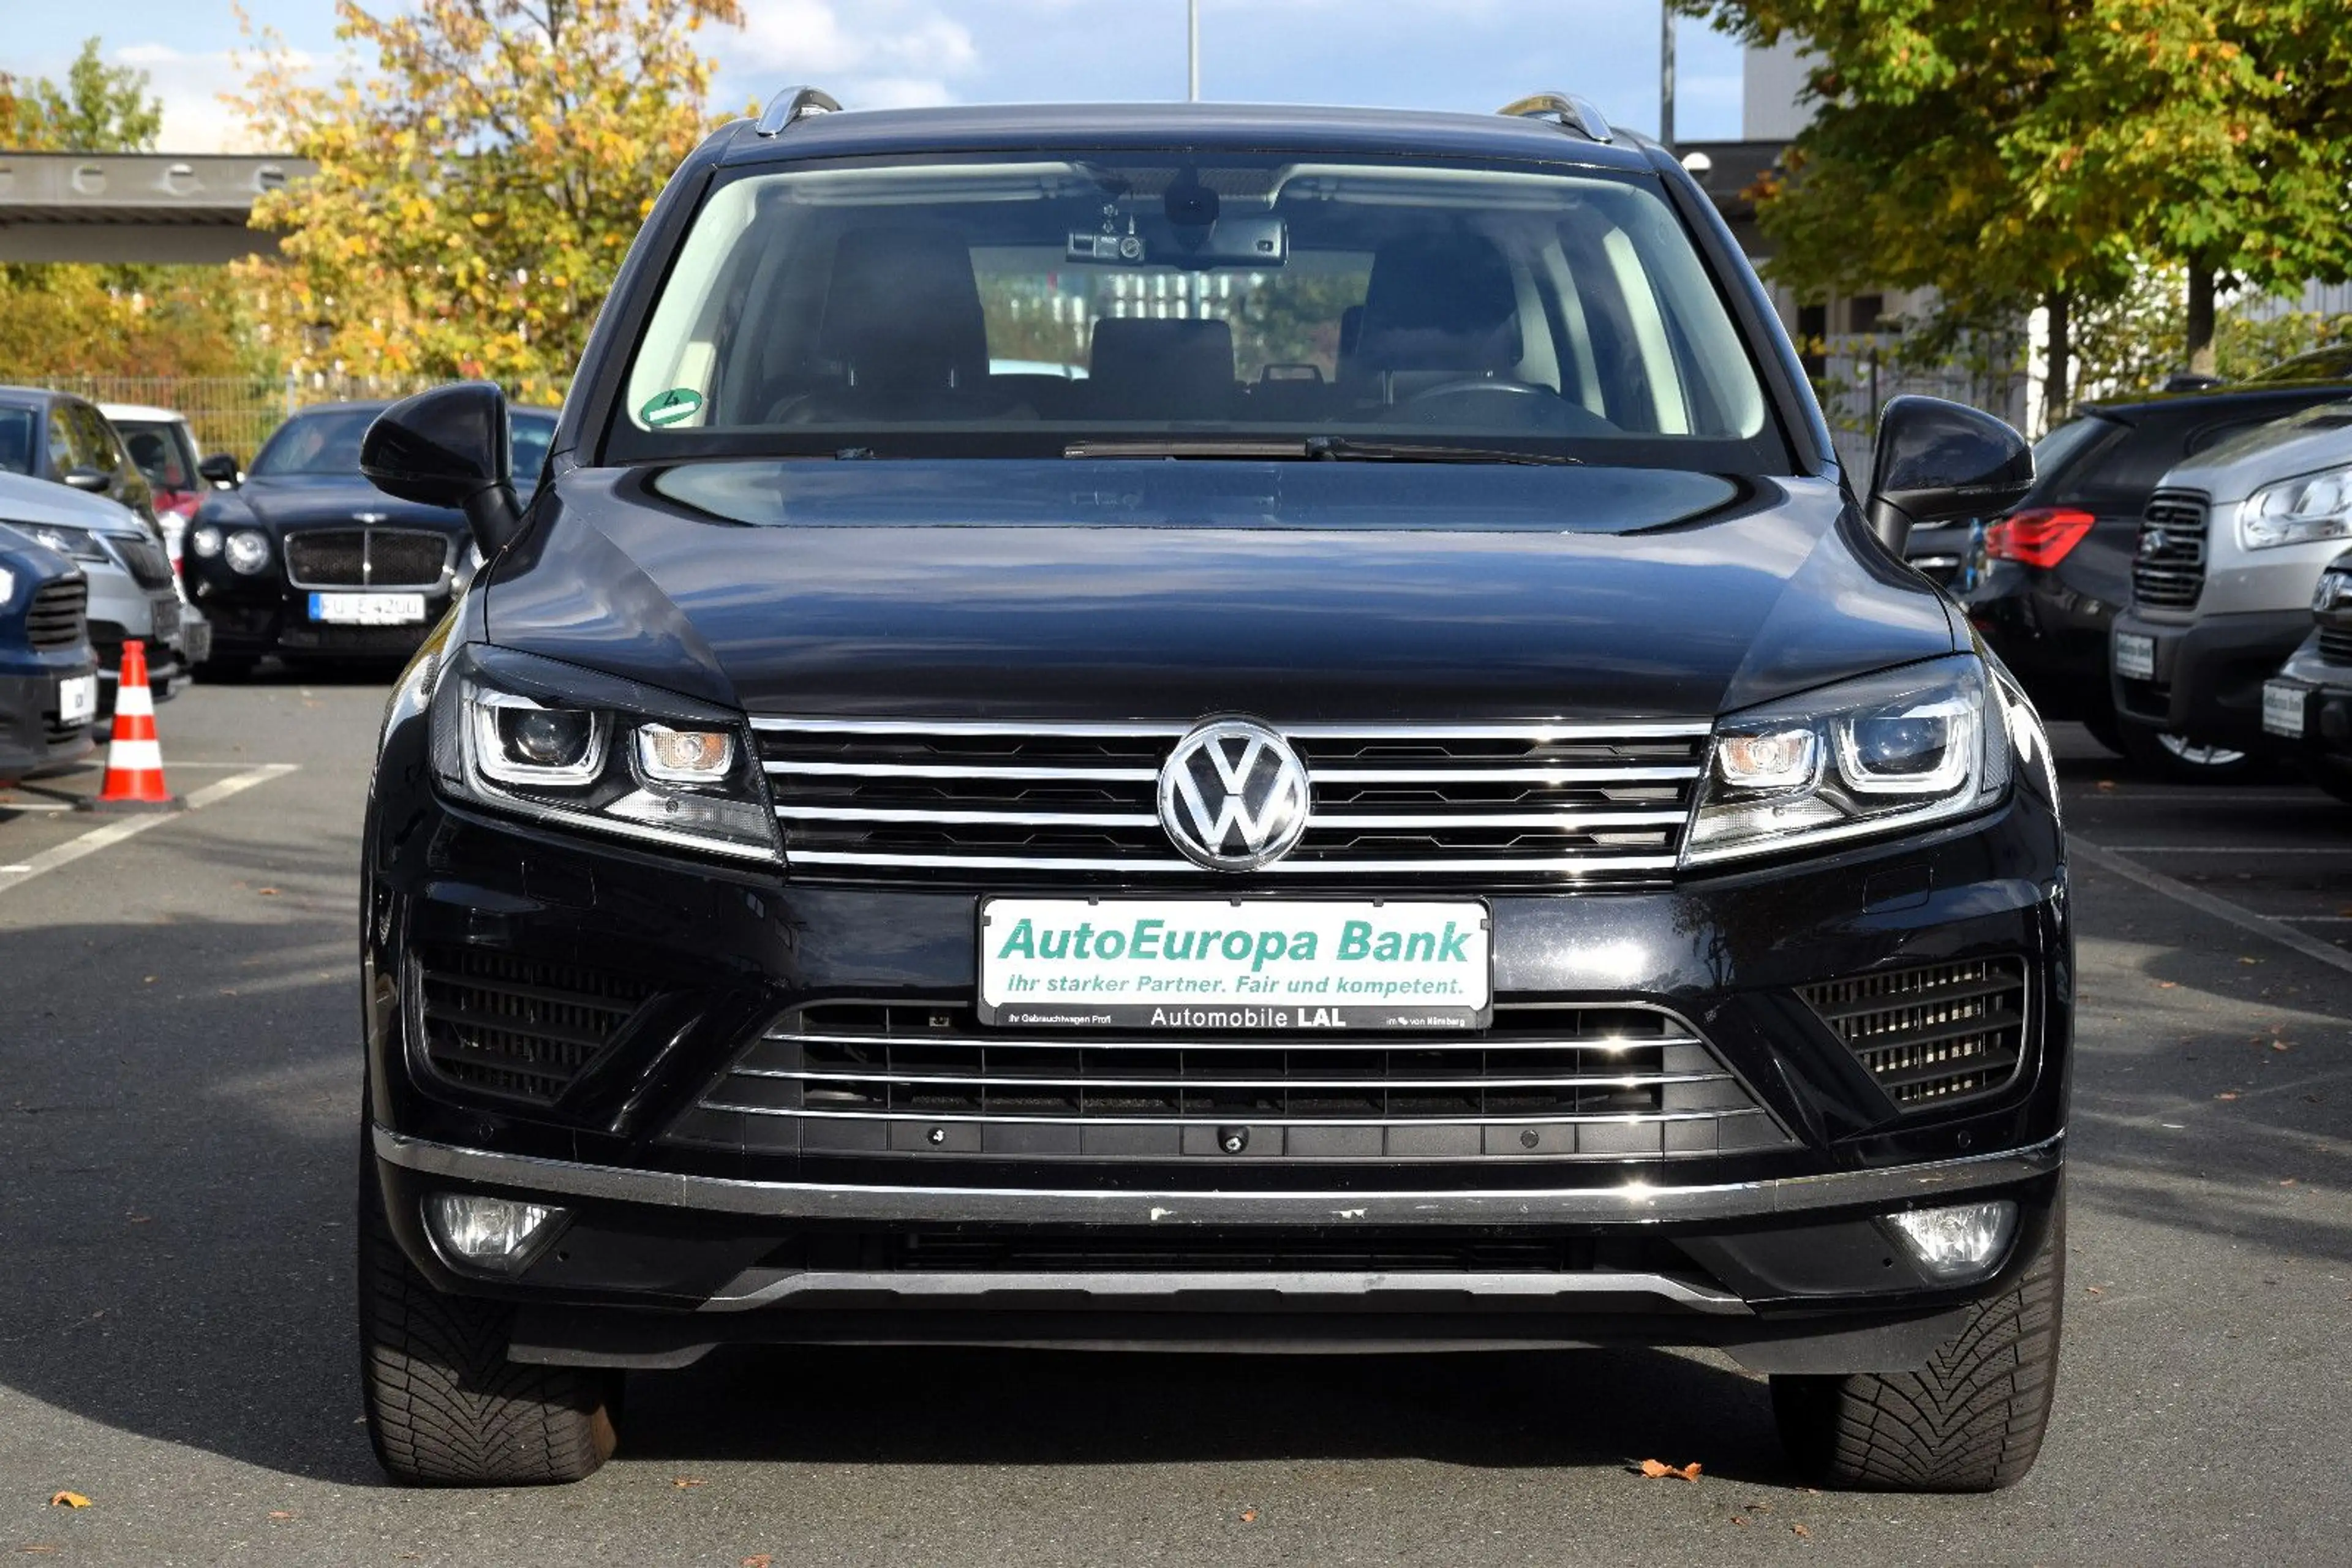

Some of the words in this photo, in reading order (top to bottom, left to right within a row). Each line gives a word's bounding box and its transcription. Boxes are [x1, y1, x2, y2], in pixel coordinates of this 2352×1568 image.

[663, 389, 680, 405] 4
[998, 918, 1318, 972] AutoEuropa
[1336, 920, 1471, 962] Bank
[1047, 974, 1130, 992] starker
[1136, 975, 1227, 993] Partner.
[1235, 975, 1280, 993] Fair
[1287, 976, 1330, 993] und
[1336, 976, 1463, 998] kompetent.
[1021, 1014, 1090, 1025] Gebrauchtwagen
[1092, 1015, 1112, 1024] Profi
[1150, 1008, 1287, 1027] Automobile
[1297, 1008, 1347, 1027] LAL
